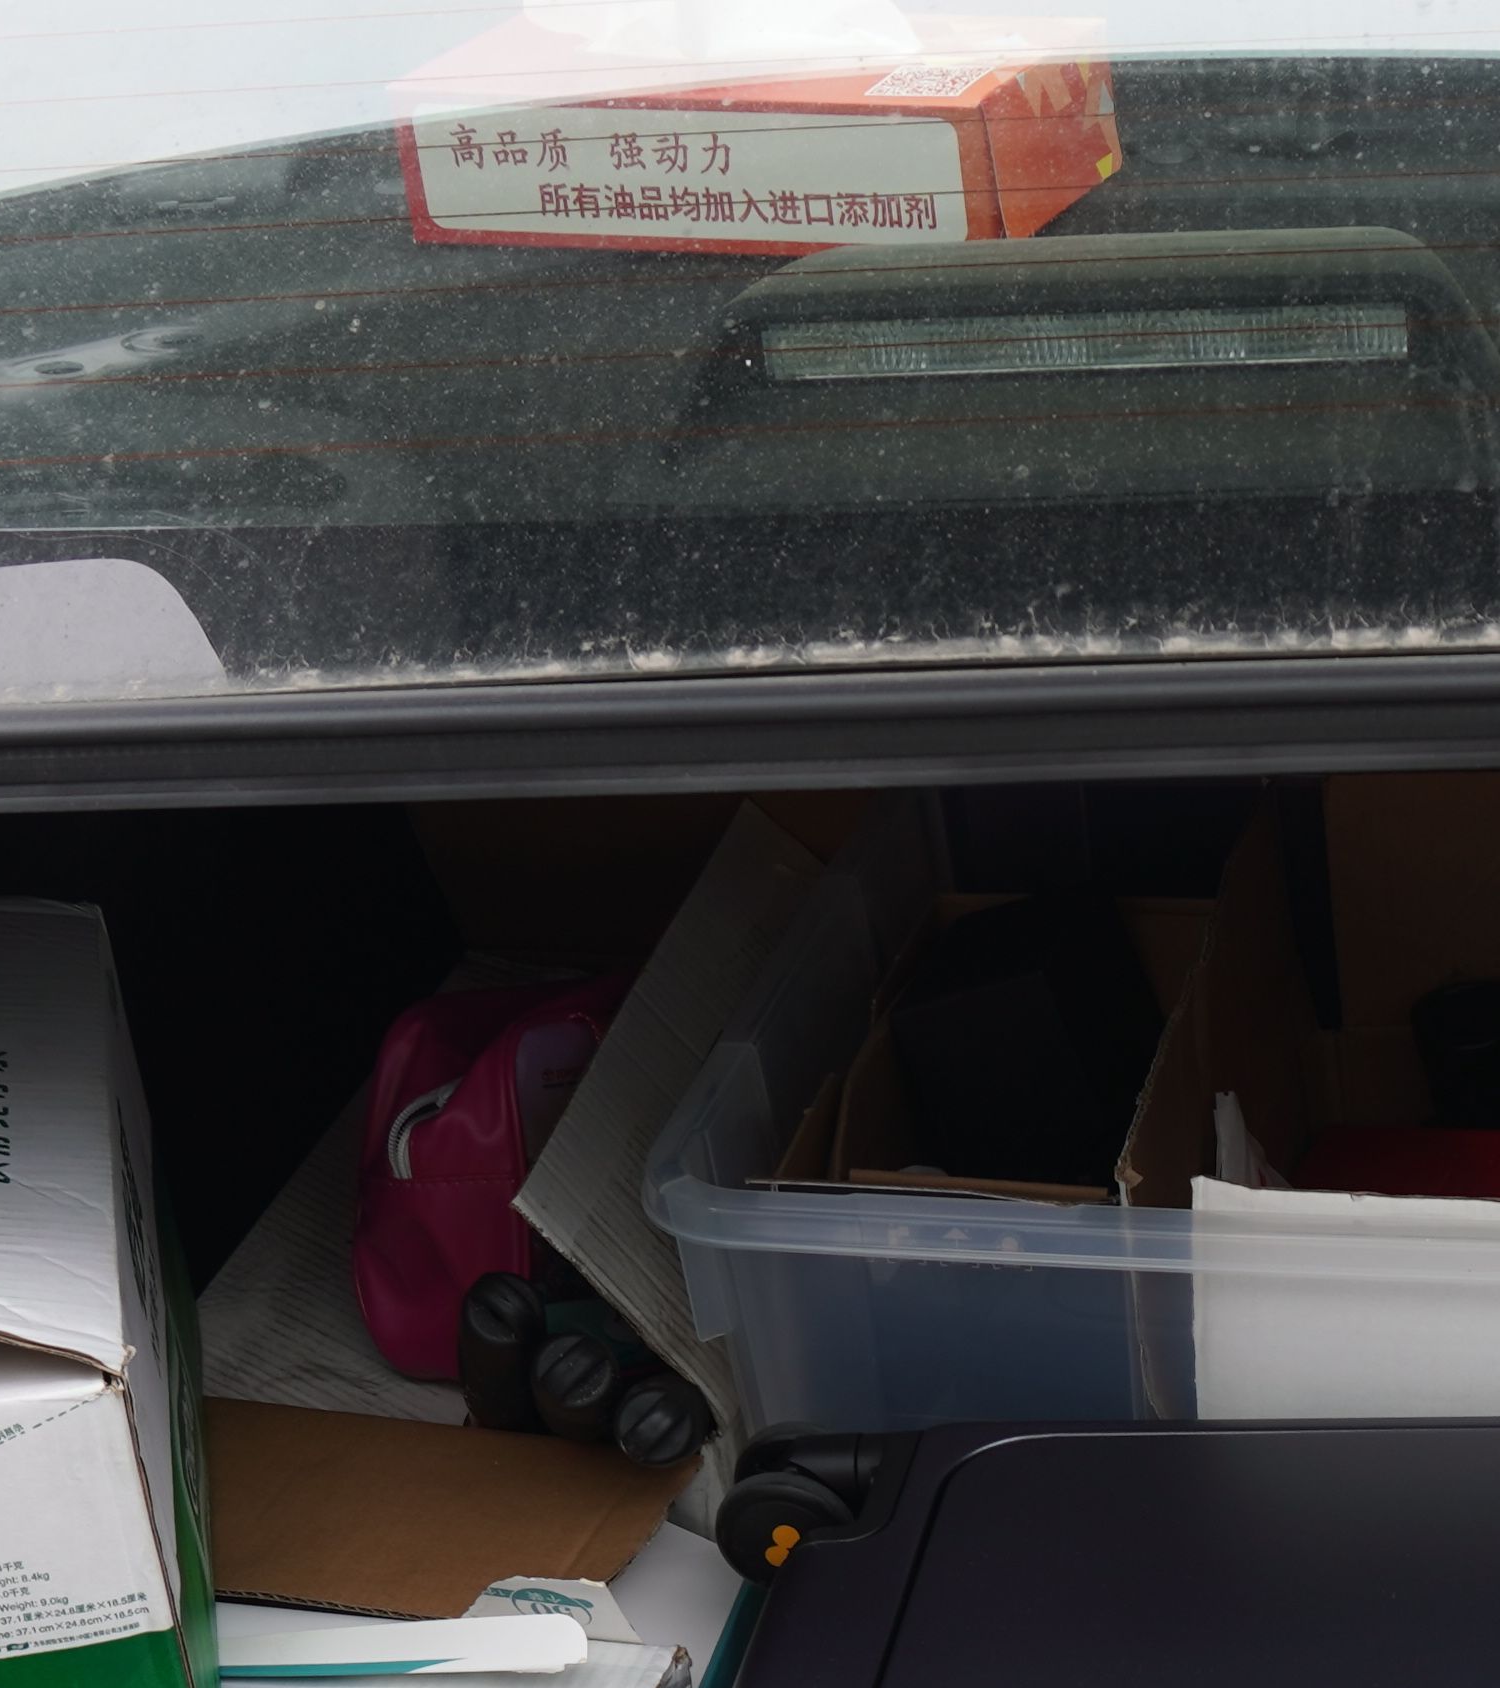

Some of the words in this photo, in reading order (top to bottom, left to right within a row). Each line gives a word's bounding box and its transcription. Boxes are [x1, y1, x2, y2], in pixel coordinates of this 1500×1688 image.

[449, 124, 571, 172] 高品质
[608, 131, 734, 176] 强动力
[538, 182, 938, 232] 所有油品均加入进口添加剂
